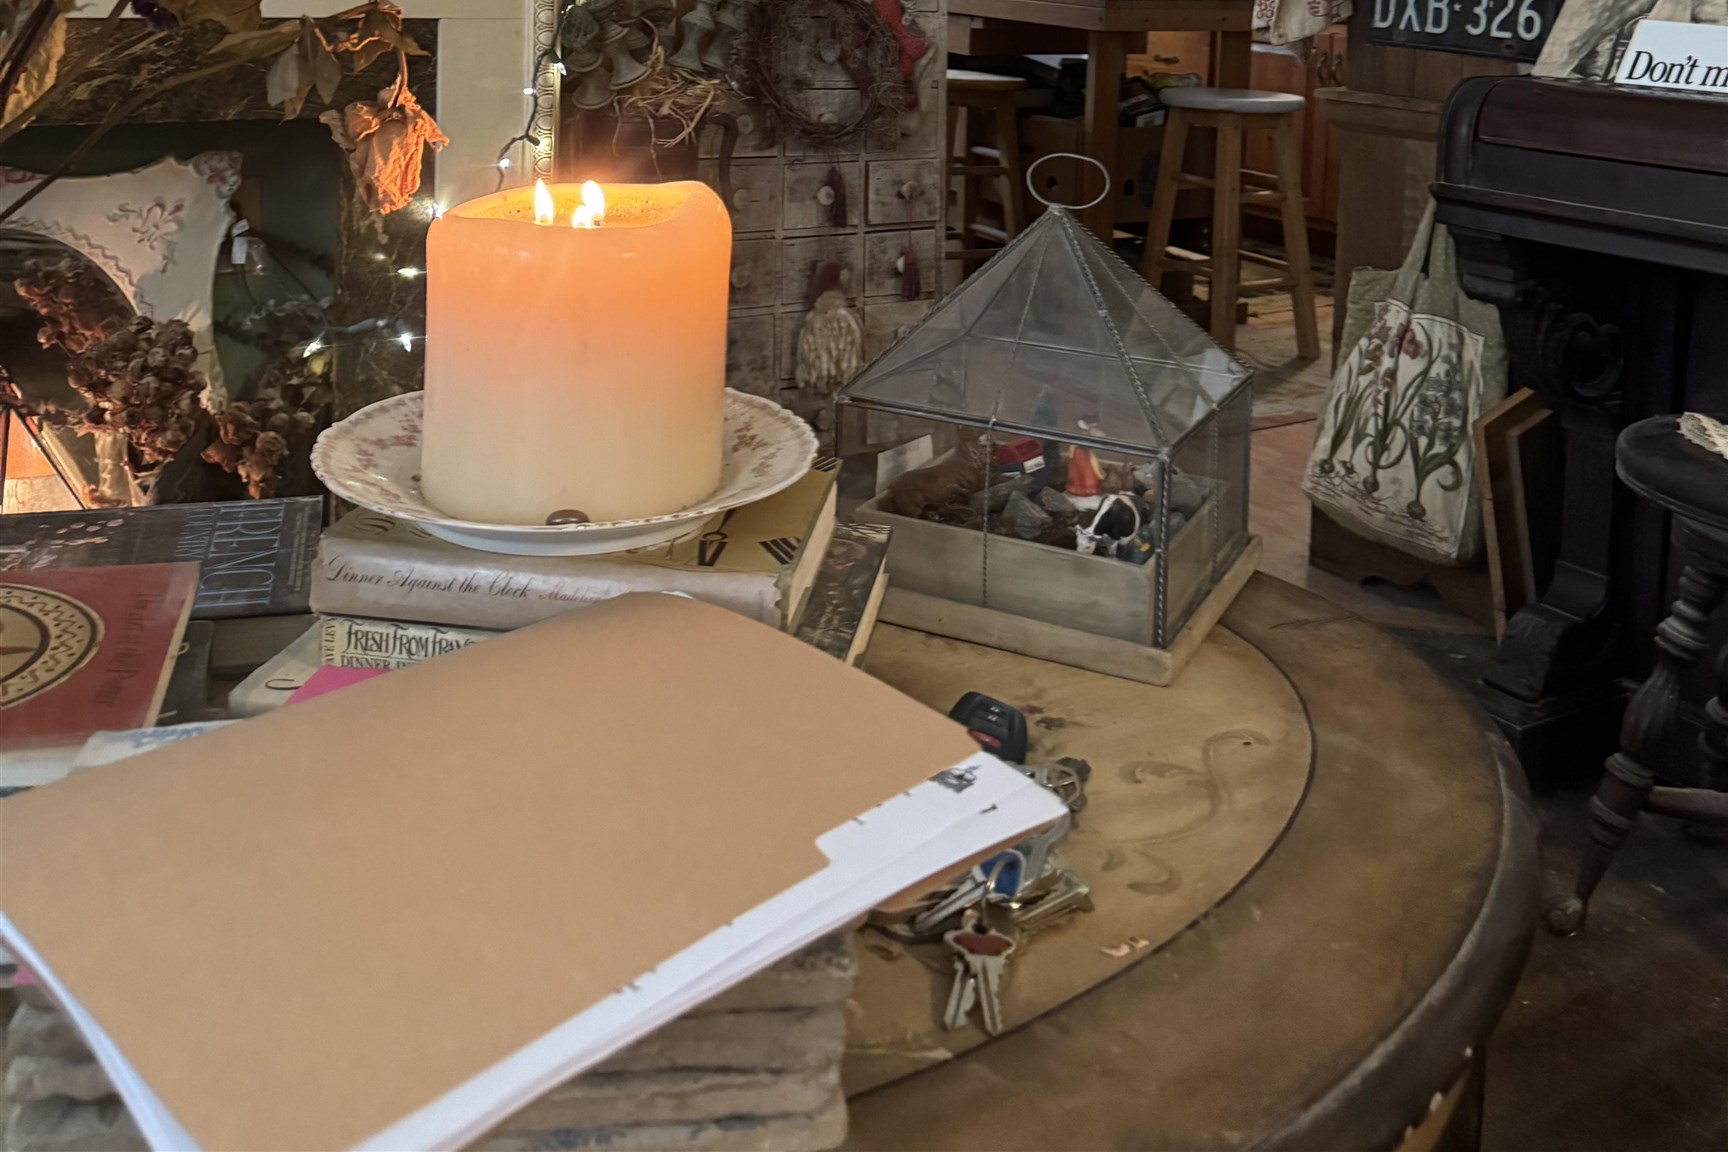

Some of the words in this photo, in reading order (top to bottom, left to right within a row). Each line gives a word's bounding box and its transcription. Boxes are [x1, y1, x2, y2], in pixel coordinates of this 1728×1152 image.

[1624, 50, 1700, 85] Don't
[194, 504, 286, 609] FRENCH
[326, 554, 385, 585] Dinner
[386, 568, 455, 595] Against
[458, 573, 482, 594] the
[488, 569, 531, 599] Clock
[341, 619, 391, 655] FRESH
[385, 623, 429, 659] FROM
